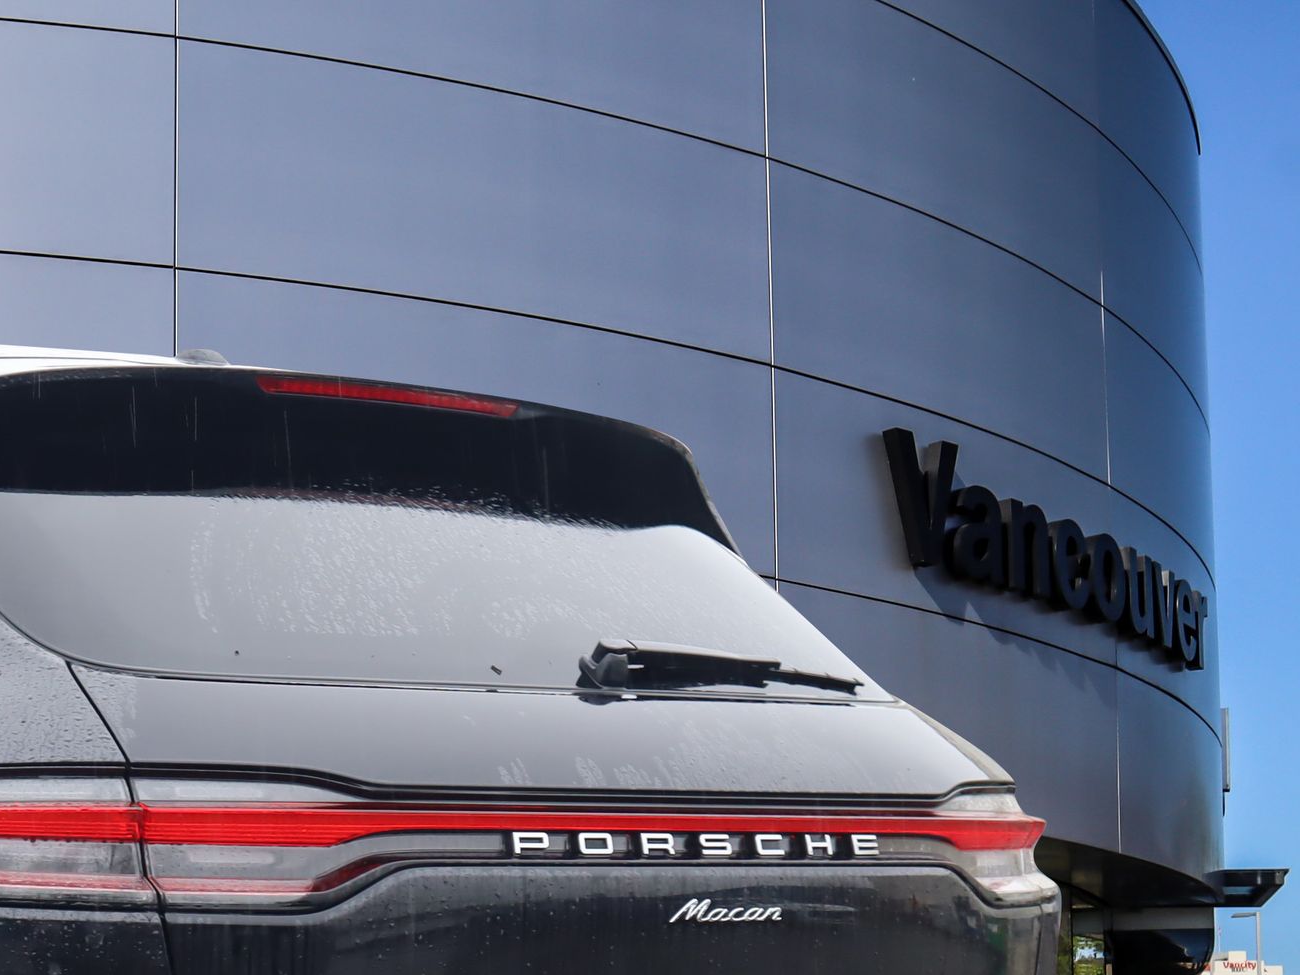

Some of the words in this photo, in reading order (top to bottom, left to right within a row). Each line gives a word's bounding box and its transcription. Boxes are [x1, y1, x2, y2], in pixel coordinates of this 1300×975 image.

[883, 427, 1208, 671] Vancouver
[512, 830, 880, 857] PORSCHE
[669, 897, 783, 924] Macan
[1222, 960, 1257, 971] Vancity
